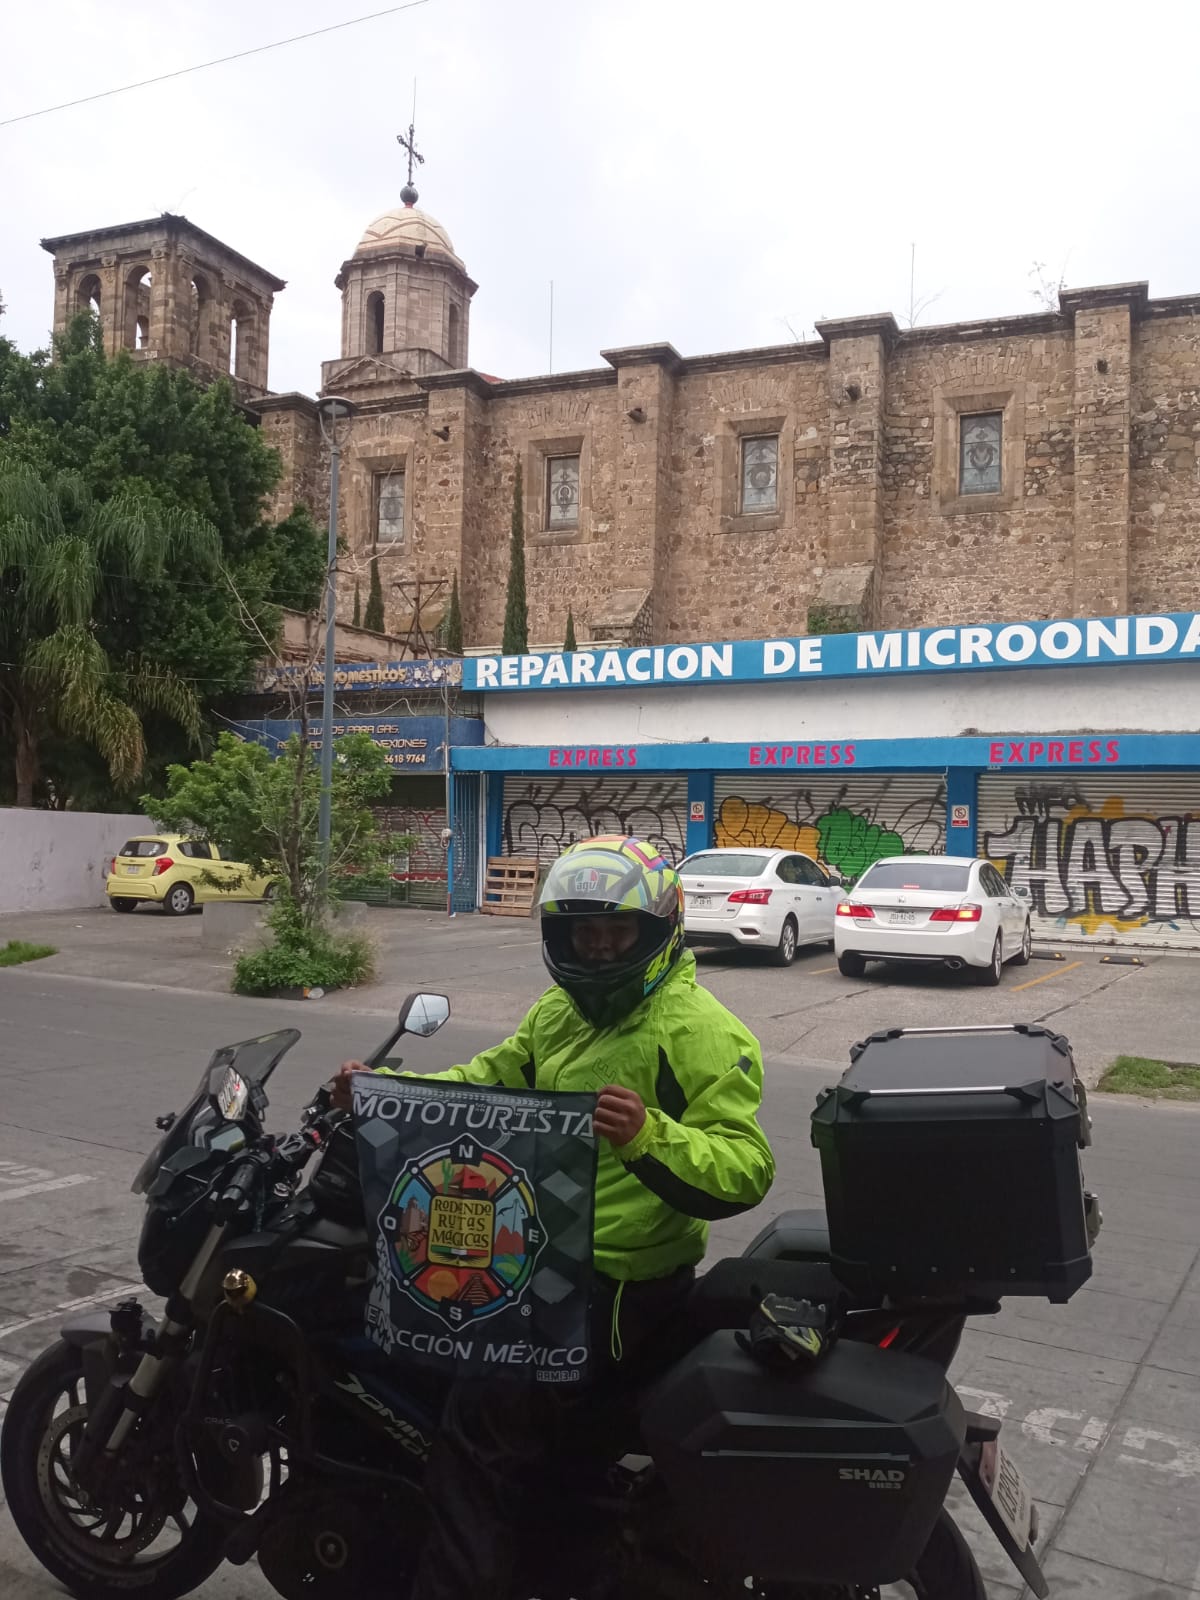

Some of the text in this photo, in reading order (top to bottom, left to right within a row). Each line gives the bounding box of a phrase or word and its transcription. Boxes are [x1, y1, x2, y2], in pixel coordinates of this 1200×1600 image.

[476, 644, 733, 687] REPARACION
[763, 639, 823, 675] DE
[549, 749, 637, 768] EXPRESS
[749, 745, 856, 765] EXPRESS
[989, 740, 1120, 764] EXPRESS
[353, 1092, 594, 1138] MOTOTURISTA
[459, 1145, 474, 1159] N
[529, 1229, 540, 1243] E
[449, 1306, 462, 1321] S
[483, 1339, 588, 1366] MÉXICO
[838, 1468, 905, 1482] SHAD
